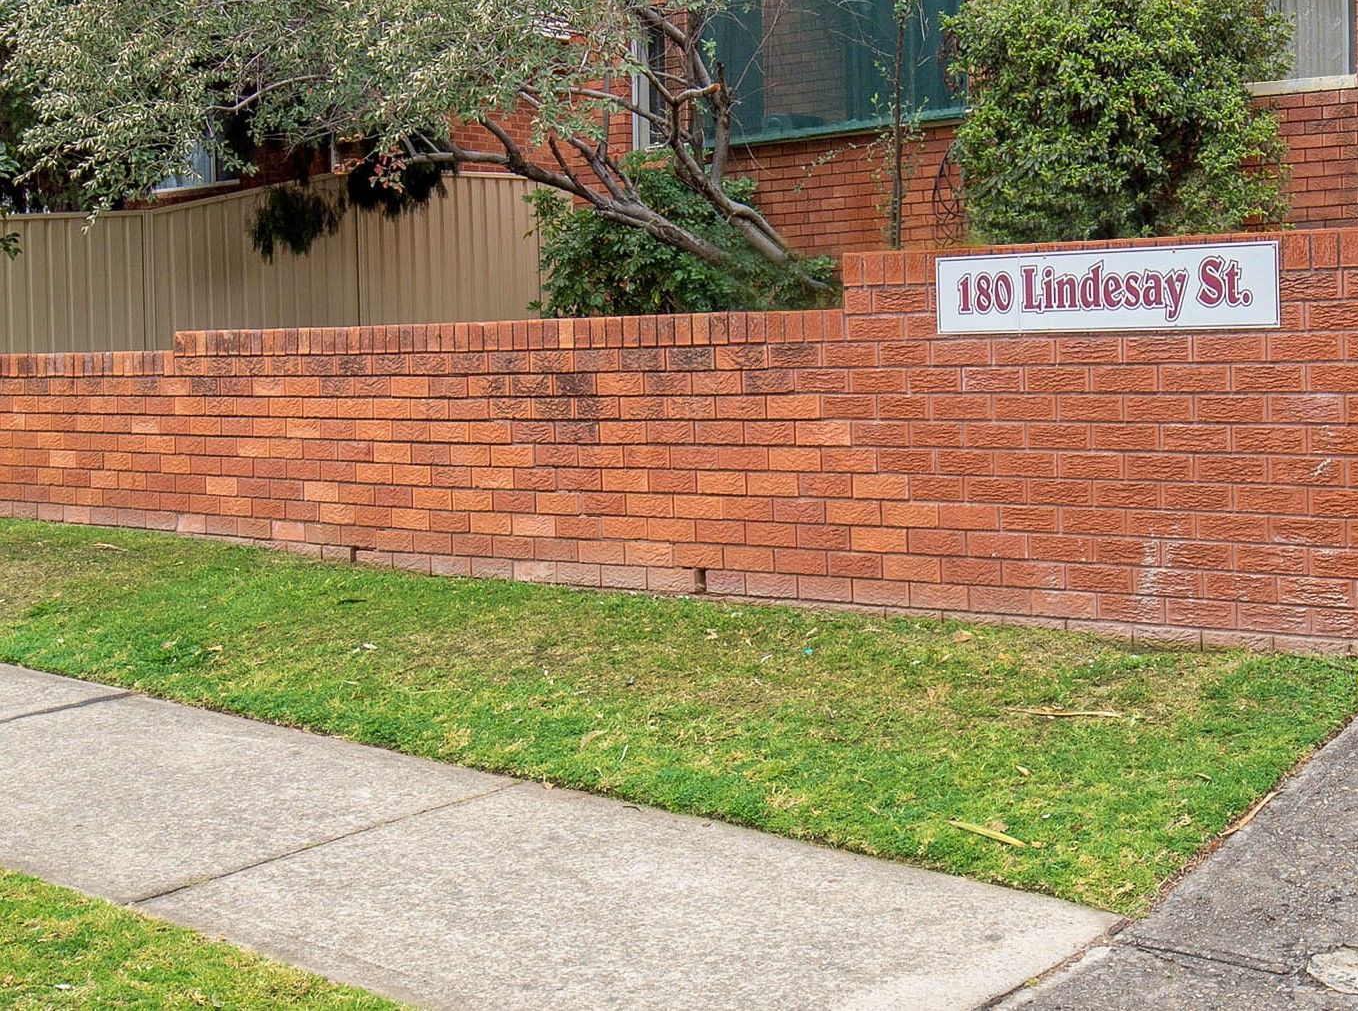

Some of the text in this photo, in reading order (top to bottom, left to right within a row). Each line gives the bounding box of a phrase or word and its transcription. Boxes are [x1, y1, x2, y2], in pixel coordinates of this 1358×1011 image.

[958, 255, 1253, 321] 180 Lindesay St.
